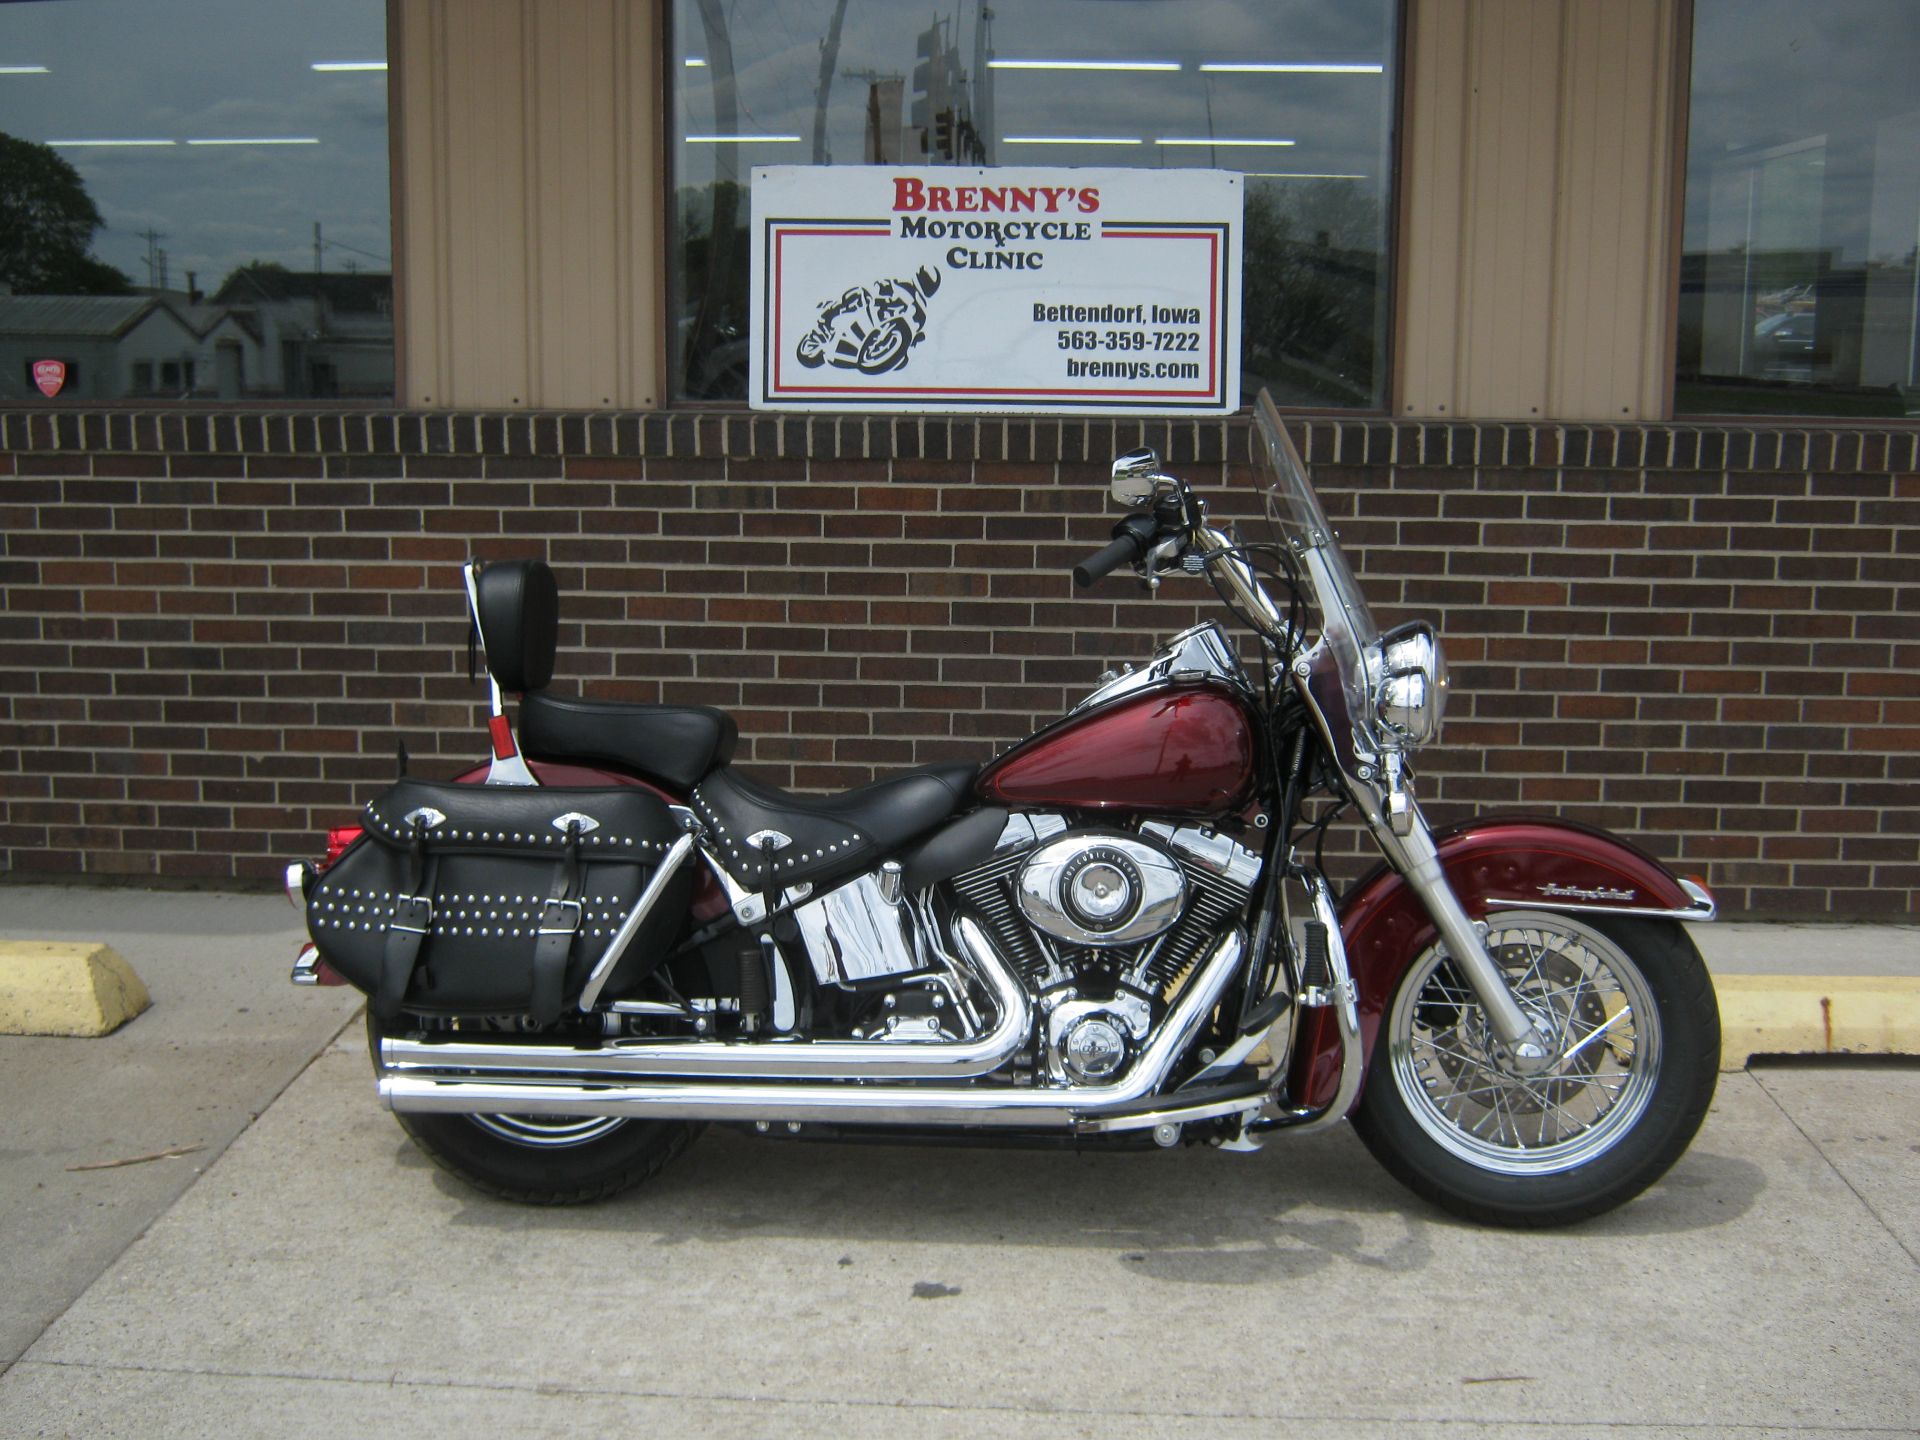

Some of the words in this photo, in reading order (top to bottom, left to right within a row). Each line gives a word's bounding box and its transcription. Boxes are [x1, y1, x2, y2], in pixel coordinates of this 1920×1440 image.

[892, 177, 1100, 213] BRENNY'S
[900, 216, 1092, 243] MOTORCYCLE
[946, 246, 1044, 270] CLINIC
[1033, 303, 1147, 325] Bettendorf,
[1152, 304, 1201, 324] Iowa
[1057, 330, 1200, 352] 563-359-7222
[1066, 358, 1200, 380] brennys.com
[1077, 851, 1107, 865] CUBIC
[1111, 854, 1140, 884] INCHES
